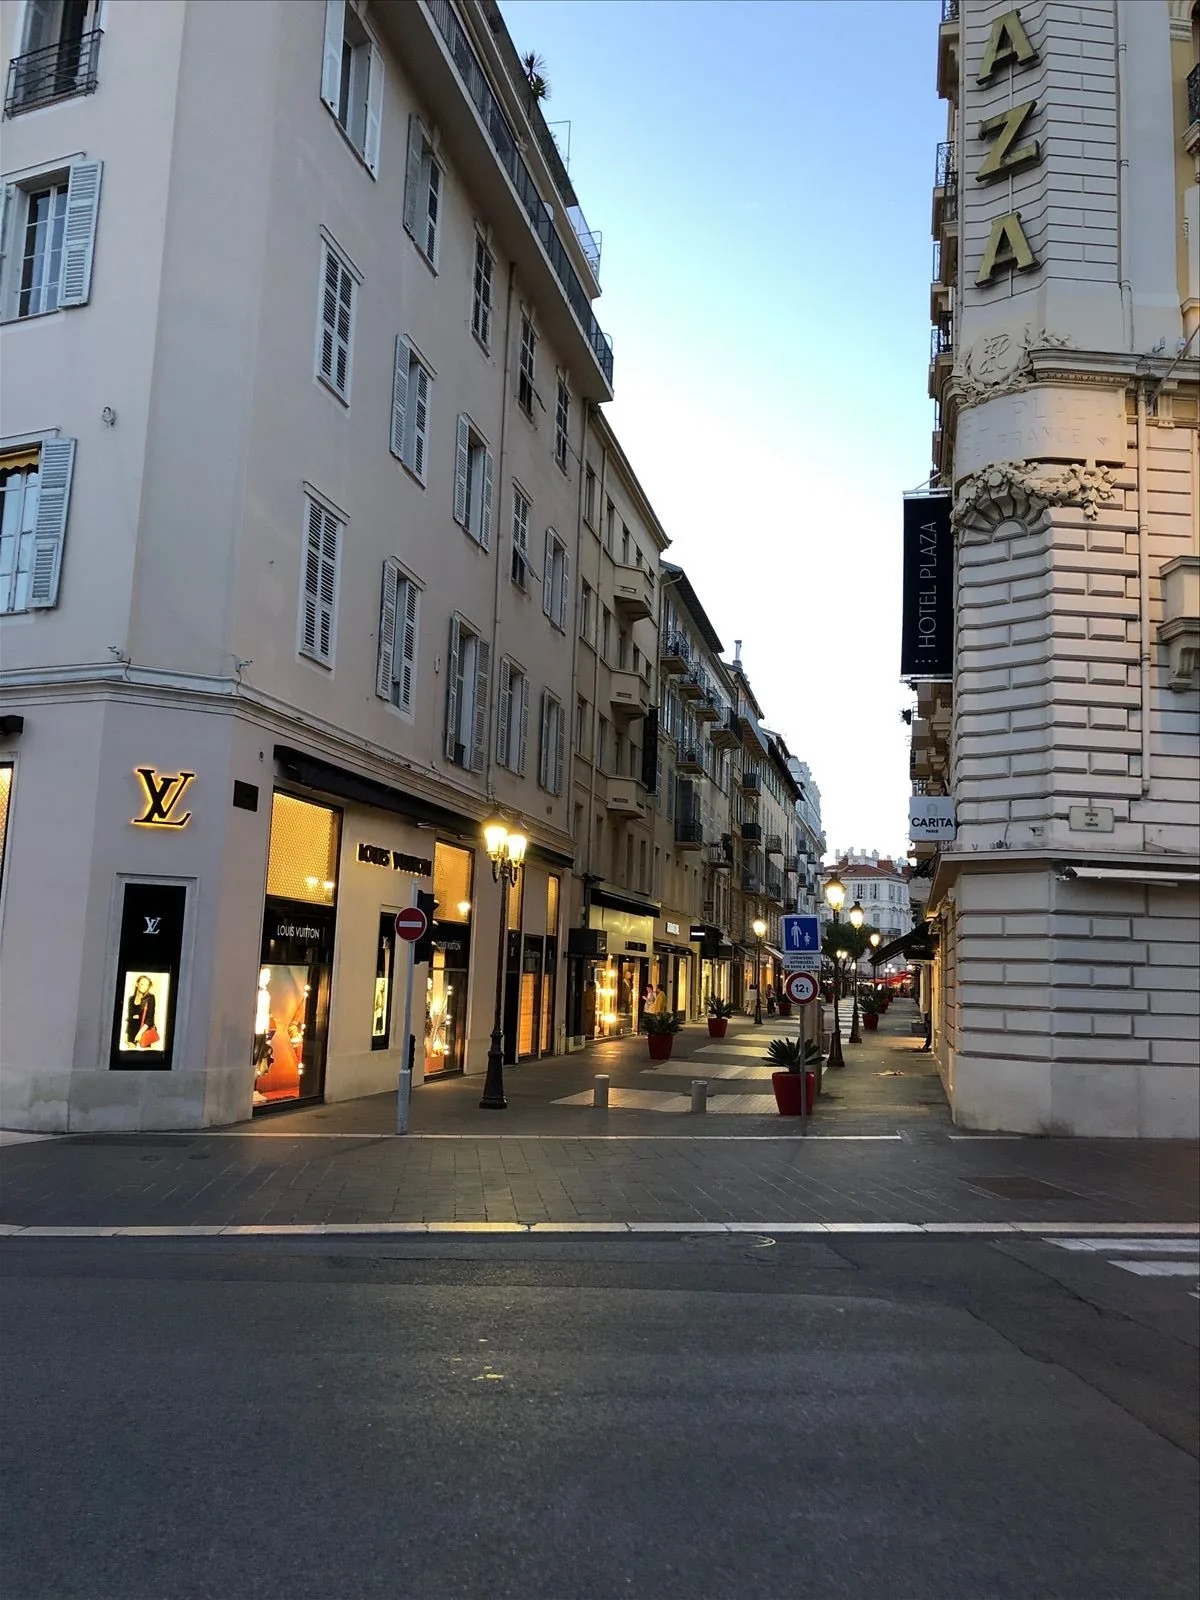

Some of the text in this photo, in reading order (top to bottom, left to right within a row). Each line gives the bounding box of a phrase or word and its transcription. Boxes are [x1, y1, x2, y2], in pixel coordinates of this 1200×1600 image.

[918, 521, 937, 648] HOTEL PLAZA
[911, 817, 953, 828] CARITA
[277, 924, 320, 939] LOUIS VUITTON
